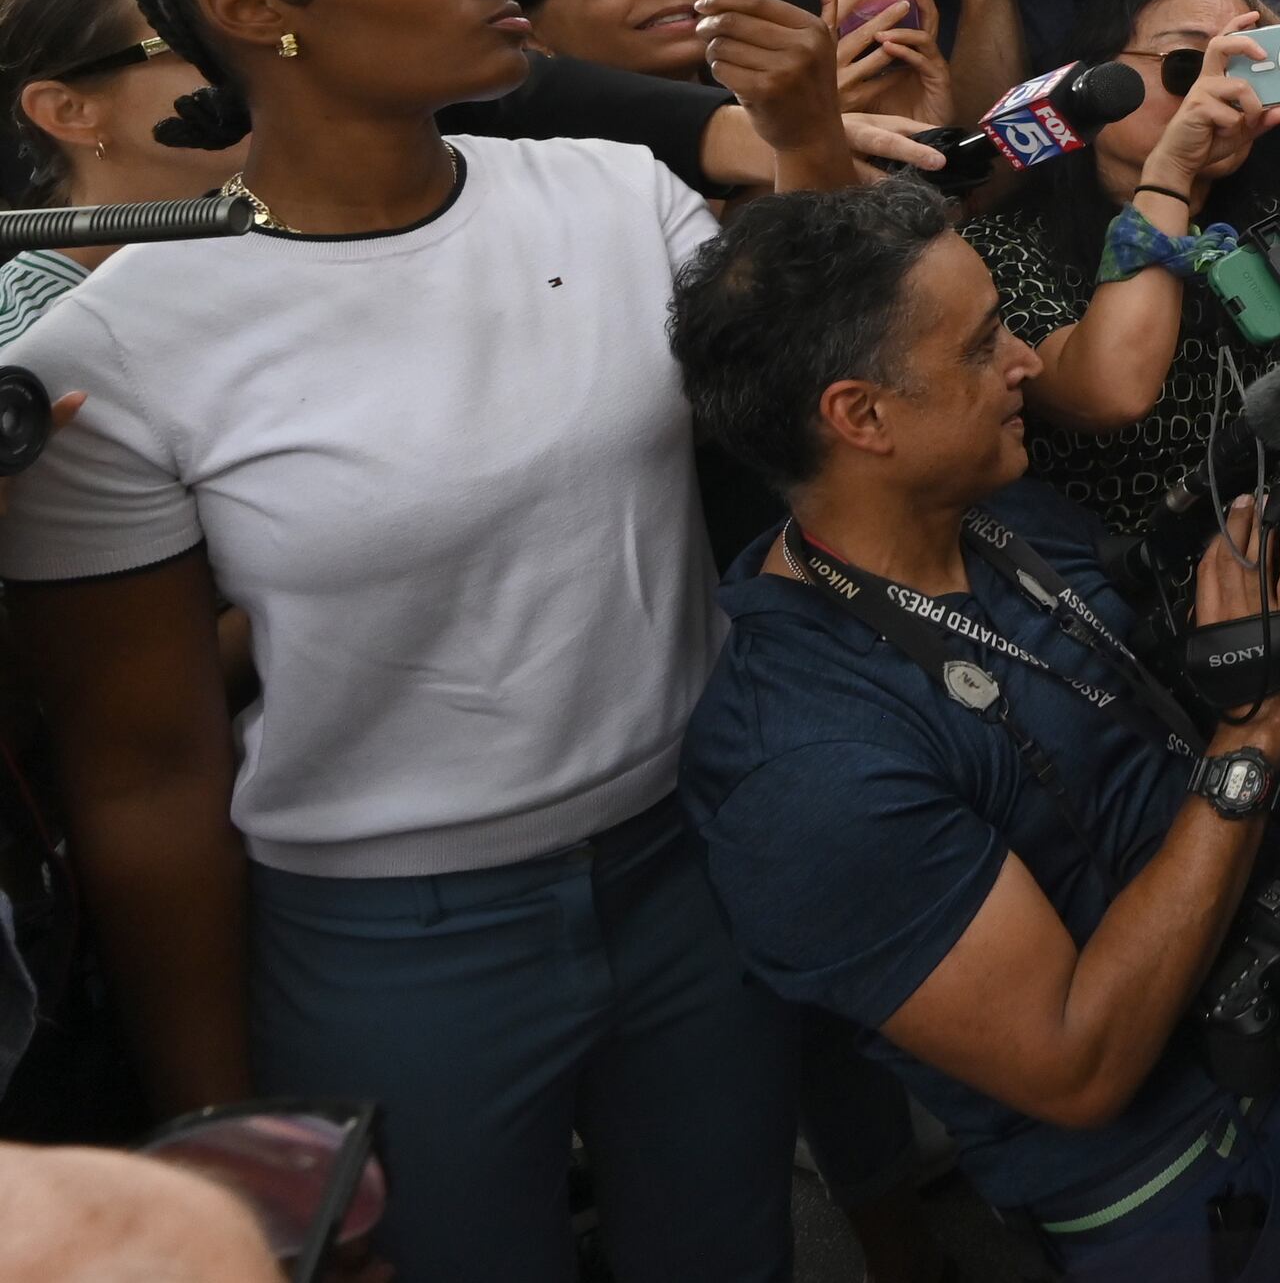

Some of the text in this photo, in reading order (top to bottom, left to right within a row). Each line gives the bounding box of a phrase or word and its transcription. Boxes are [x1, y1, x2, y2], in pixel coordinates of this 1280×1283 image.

[1005, 121, 1054, 155] 5
[1034, 105, 1078, 147] FOX
[983, 125, 1022, 169] NEWS
[961, 508, 1014, 549] PRESS
[808, 556, 860, 600] Nikon
[886, 584, 947, 623] PRESS
[1208, 644, 1265, 668] SONY
